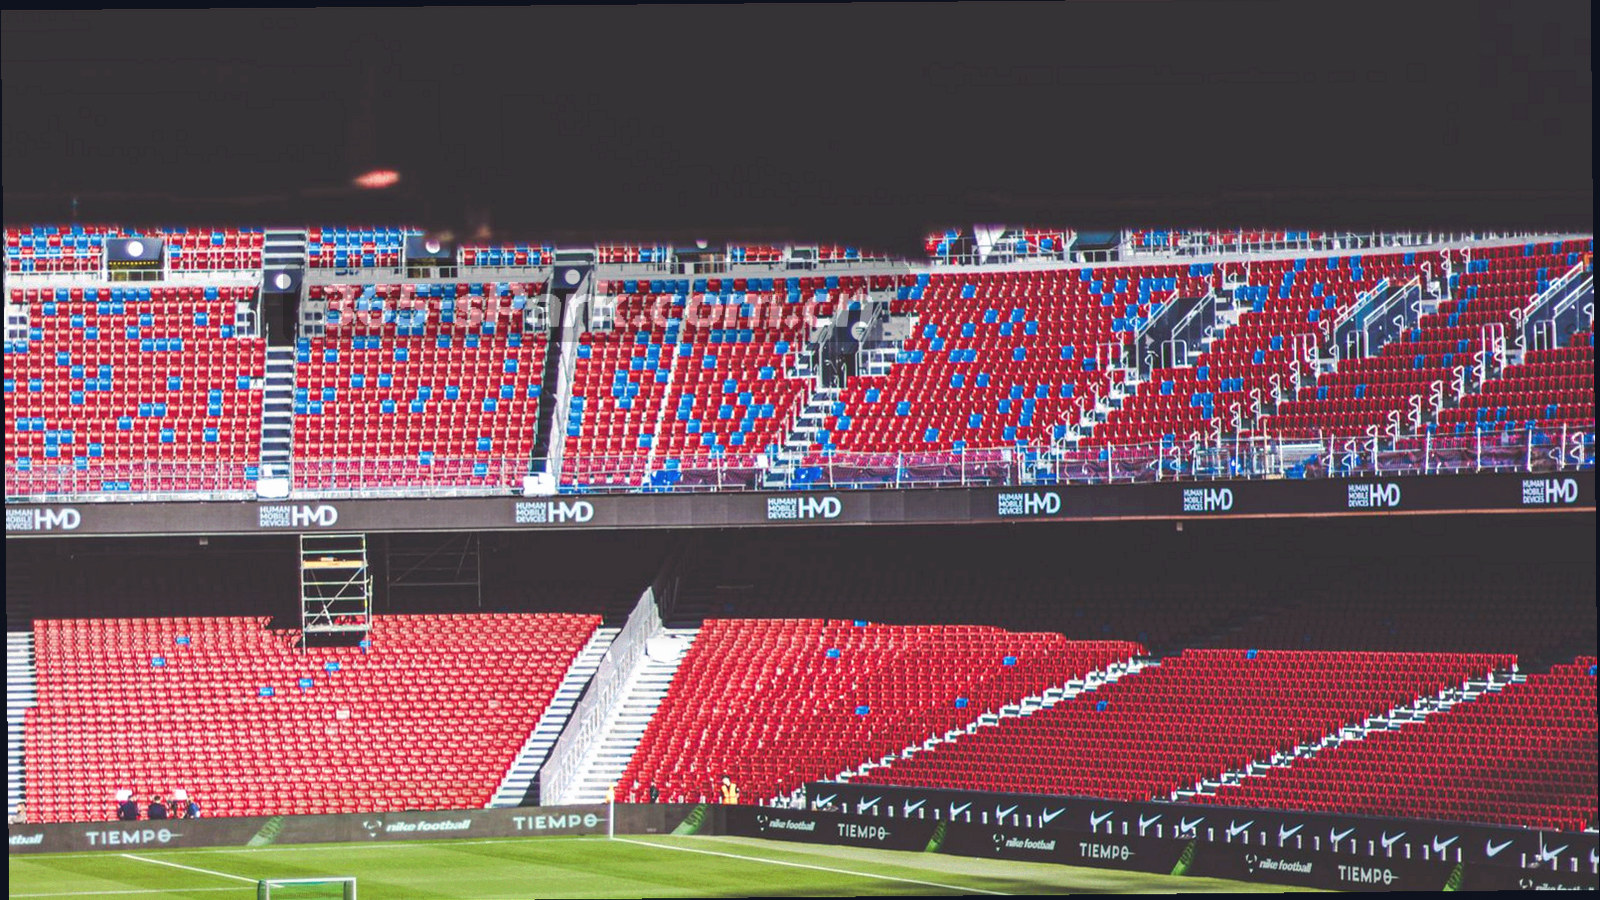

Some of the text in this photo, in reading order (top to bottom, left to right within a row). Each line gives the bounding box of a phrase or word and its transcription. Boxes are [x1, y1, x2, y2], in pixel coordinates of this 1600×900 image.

[1204, 488, 1233, 510] HMD
[1370, 483, 1401, 506] HMD
[1546, 479, 1578, 503] HMD
[548, 501, 594, 522] HMD
[798, 497, 841, 518] HMD
[1025, 492, 1061, 514] HMD
[34, 508, 80, 530] HMD
[292, 505, 338, 526] HMD
[386, 820, 472, 832] nike football
[513, 814, 608, 830] TIEMPO
[769, 819, 816, 831] nike football
[837, 824, 890, 840] TIEMPO
[86, 829, 183, 845] TIEMPO
[1006, 838, 1056, 850] nike football
[1079, 843, 1135, 860] TIEMPO
[1259, 858, 1312, 874] nike football
[1338, 865, 1399, 885] TIEMPO
